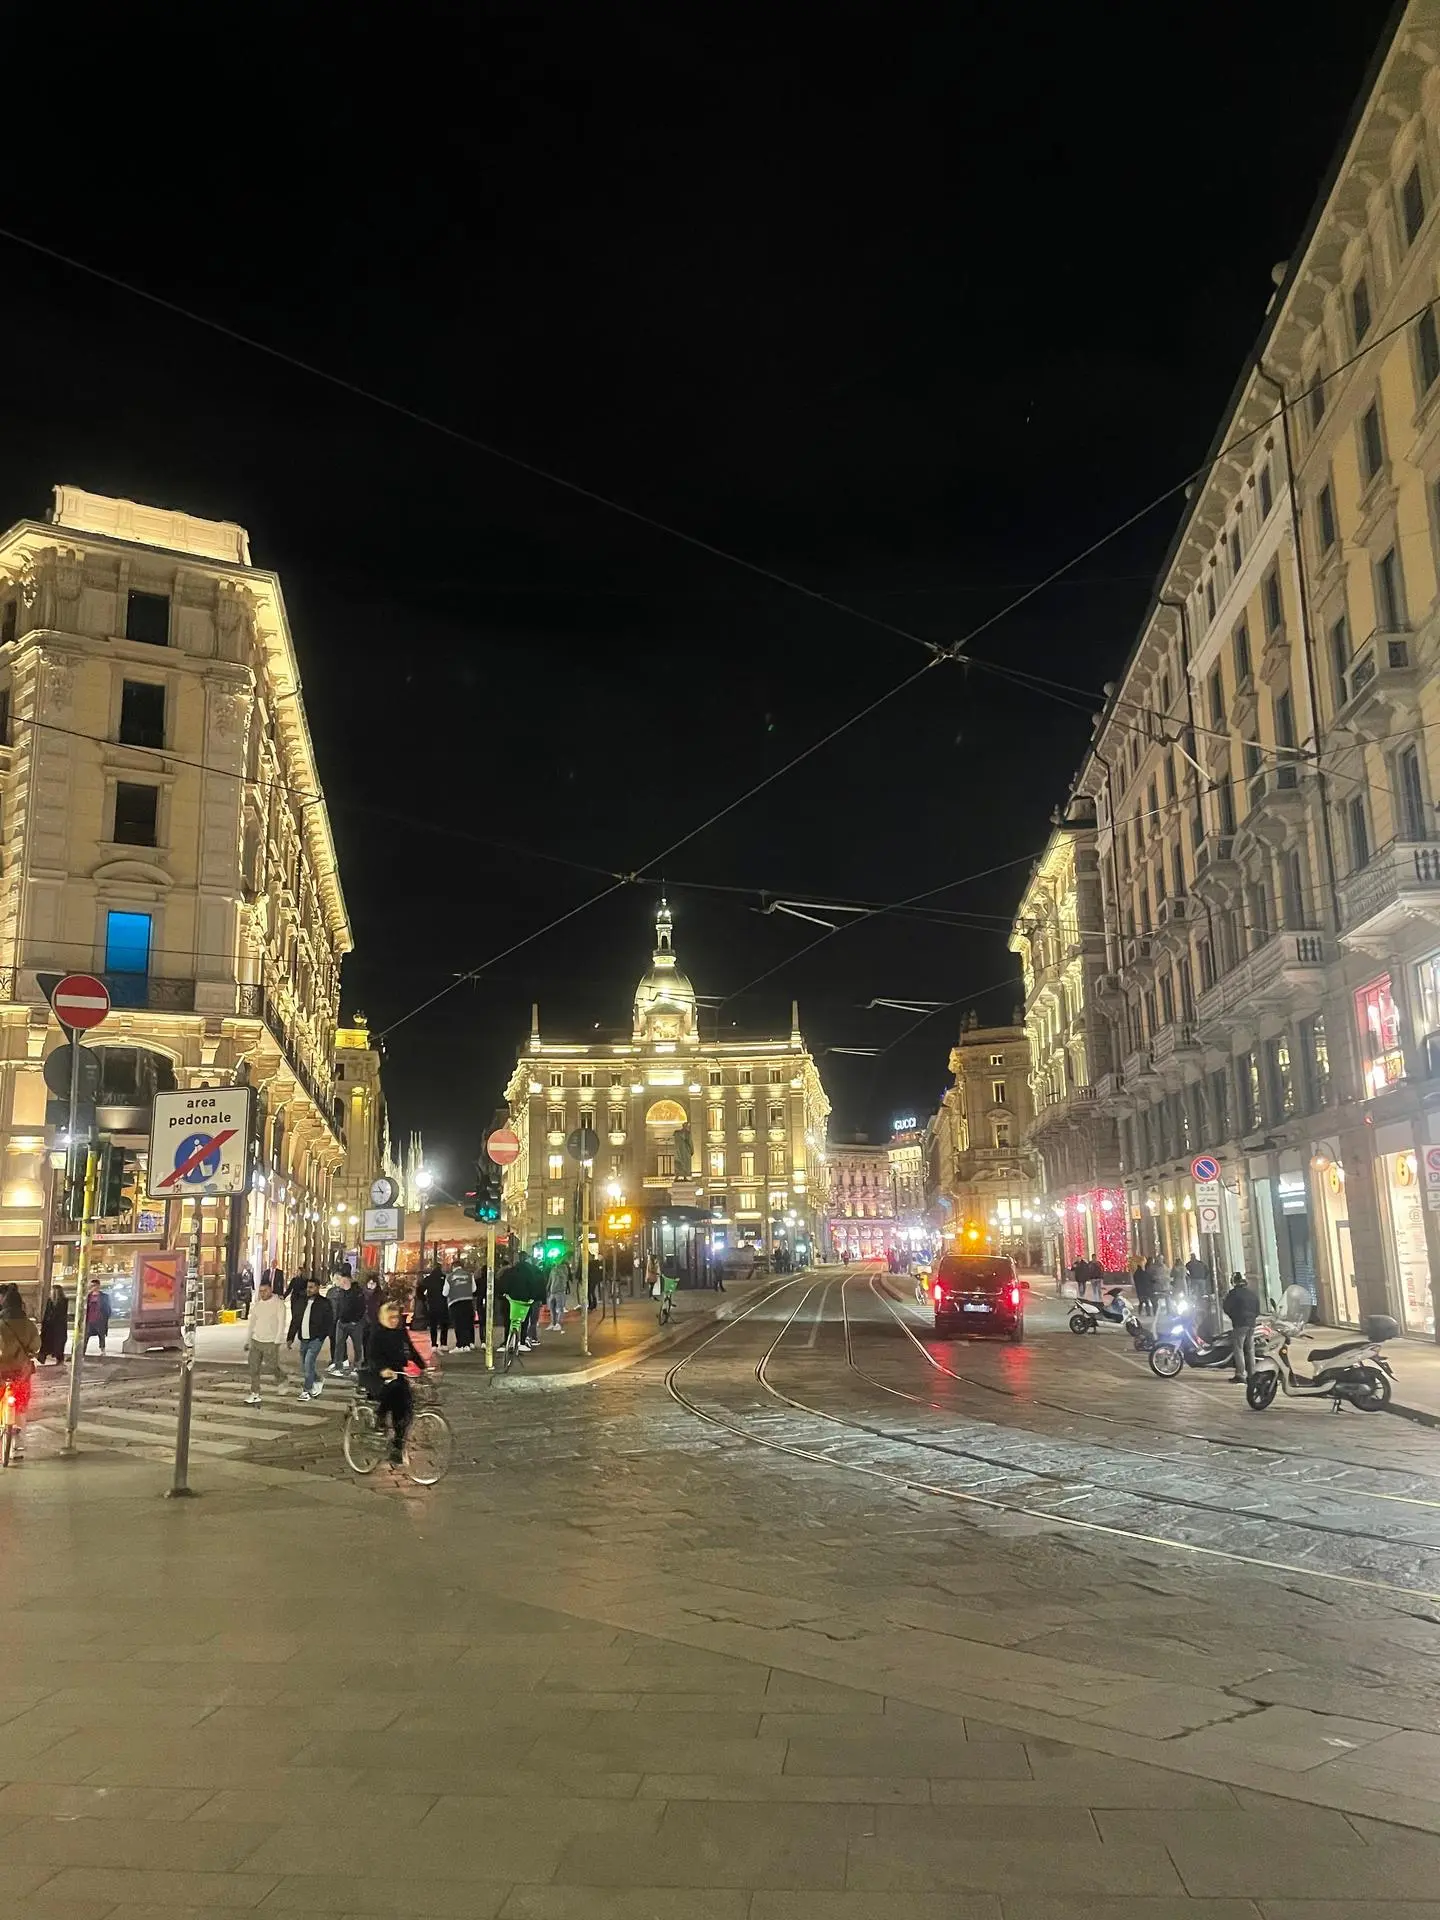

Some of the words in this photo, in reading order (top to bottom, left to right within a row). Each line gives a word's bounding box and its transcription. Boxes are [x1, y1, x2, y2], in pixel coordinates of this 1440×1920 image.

[187, 1098, 216, 1109] area
[169, 1112, 231, 1128] pedonale
[895, 1117, 917, 1130] GUCCI
